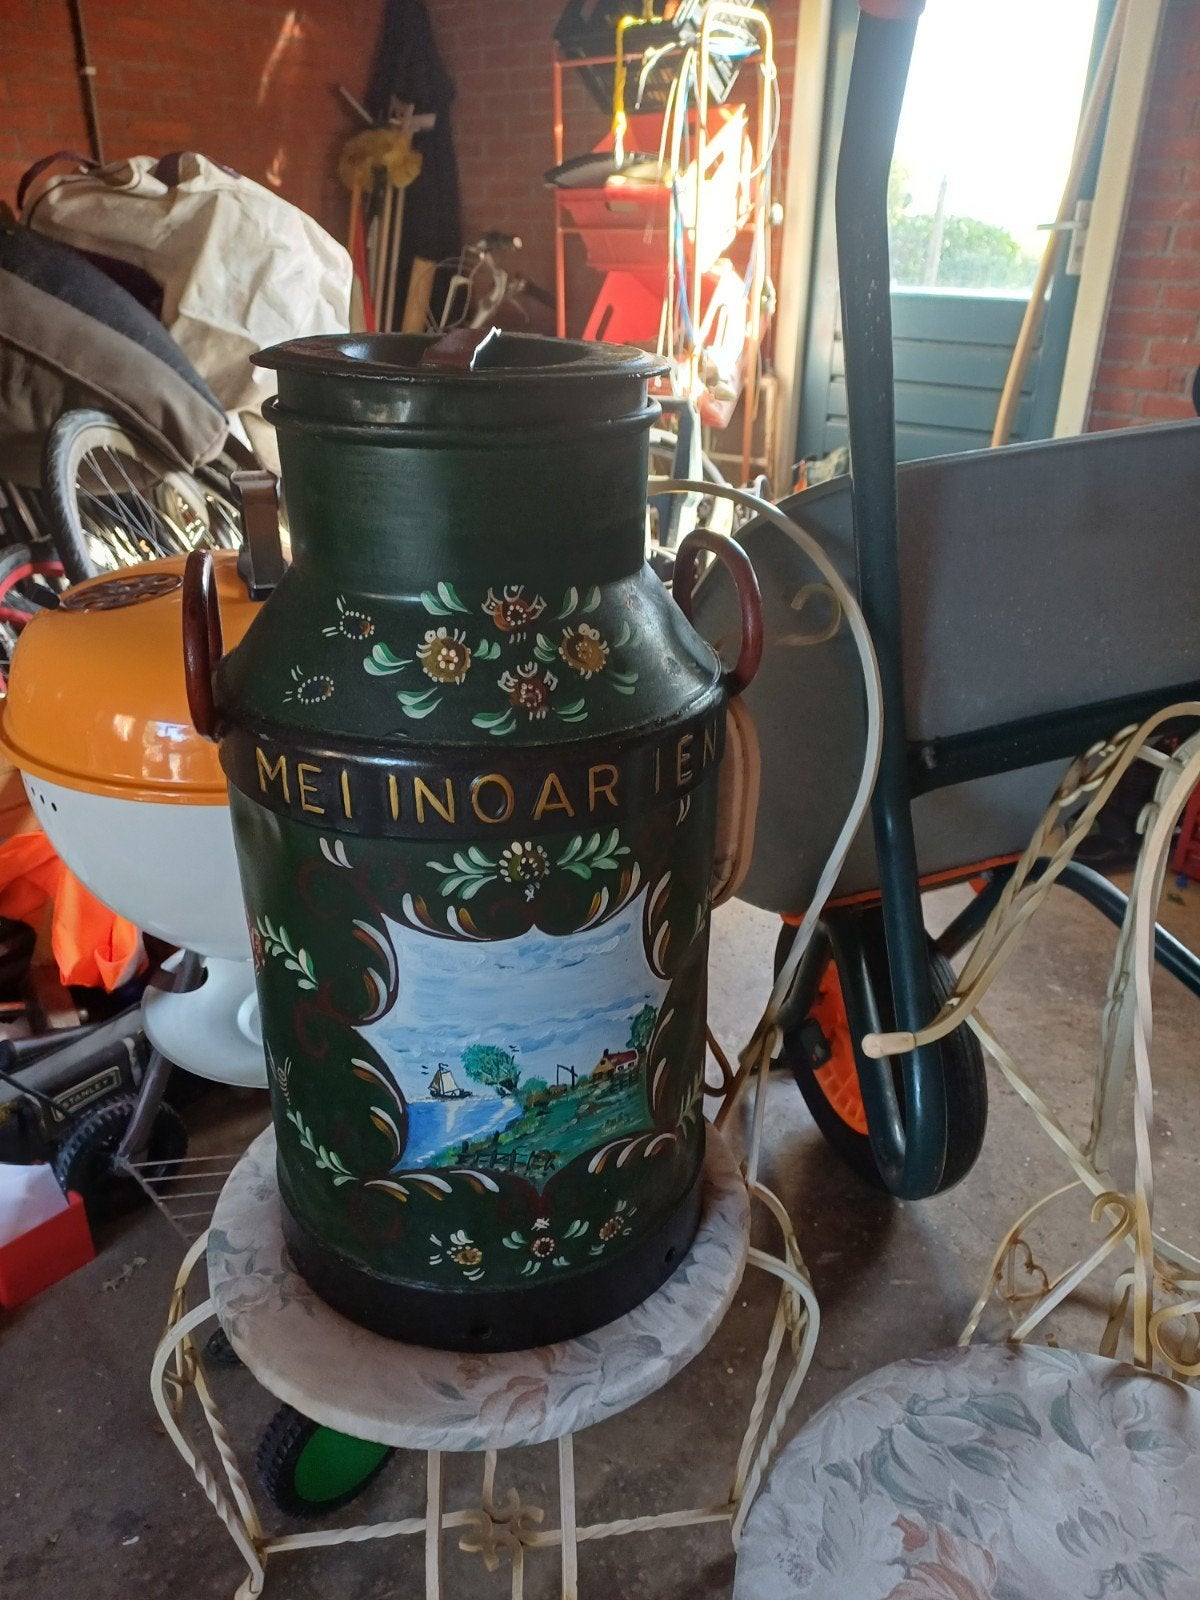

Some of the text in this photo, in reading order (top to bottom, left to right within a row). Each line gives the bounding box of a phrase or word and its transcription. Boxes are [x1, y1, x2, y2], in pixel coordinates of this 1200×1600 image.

[254, 718, 718, 825] MEI INOAR IEN
